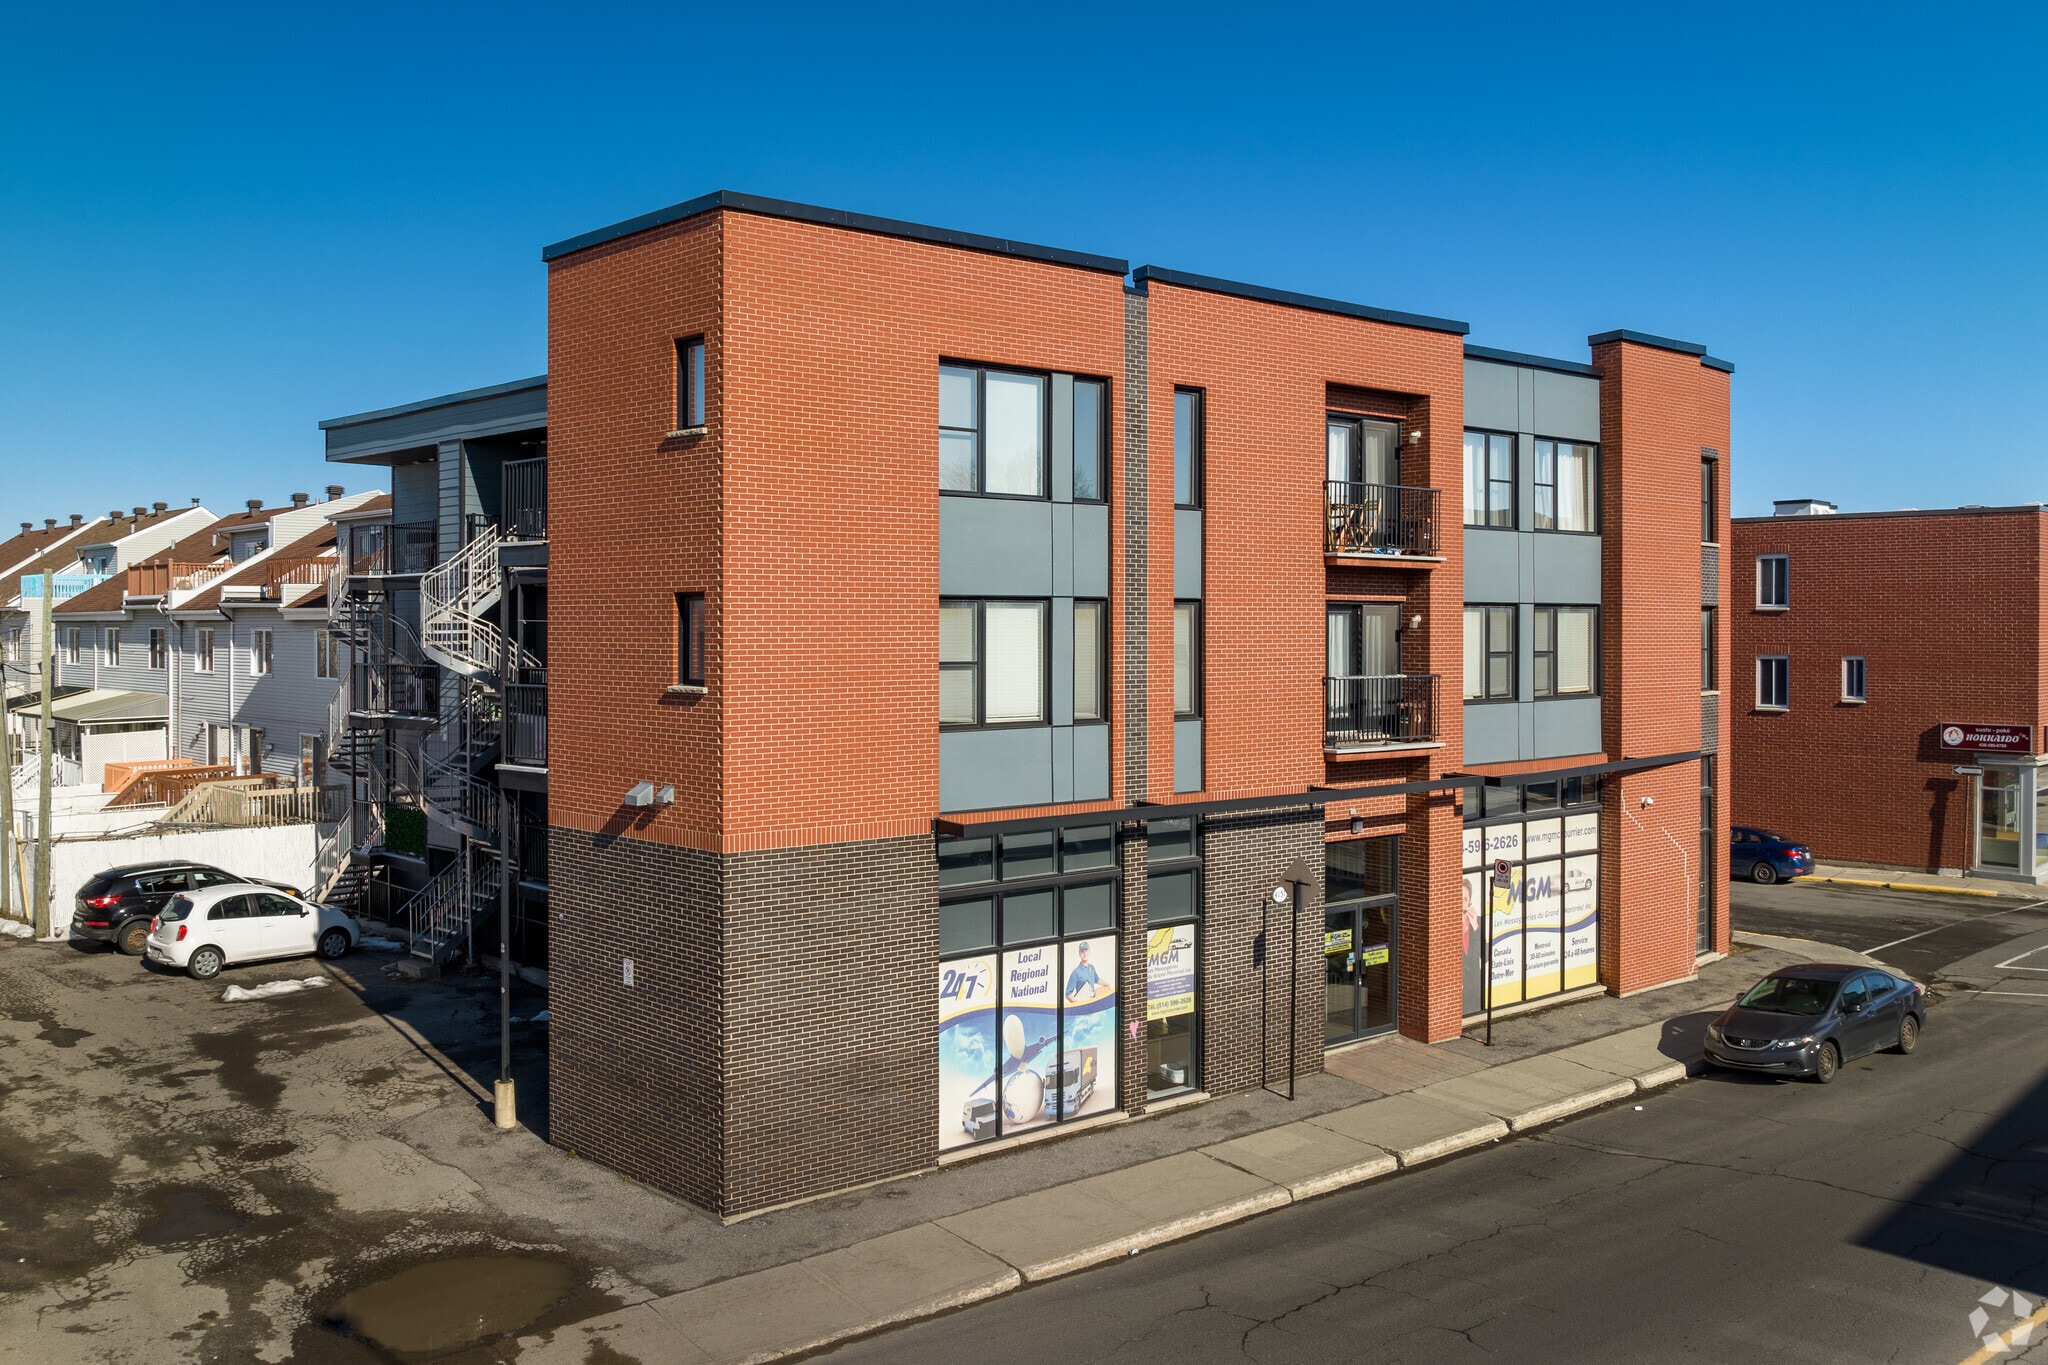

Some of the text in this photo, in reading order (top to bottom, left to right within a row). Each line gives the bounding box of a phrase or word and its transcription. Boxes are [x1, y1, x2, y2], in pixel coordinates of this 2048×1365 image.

[1966, 734, 2020, 743] HOKKAIDO
[1507, 875, 1551, 905] MGM
[1571, 936, 1589, 946] Service
[1018, 949, 1042, 964] Local
[1149, 950, 1179, 967] MGM
[1011, 982, 1048, 998] National
